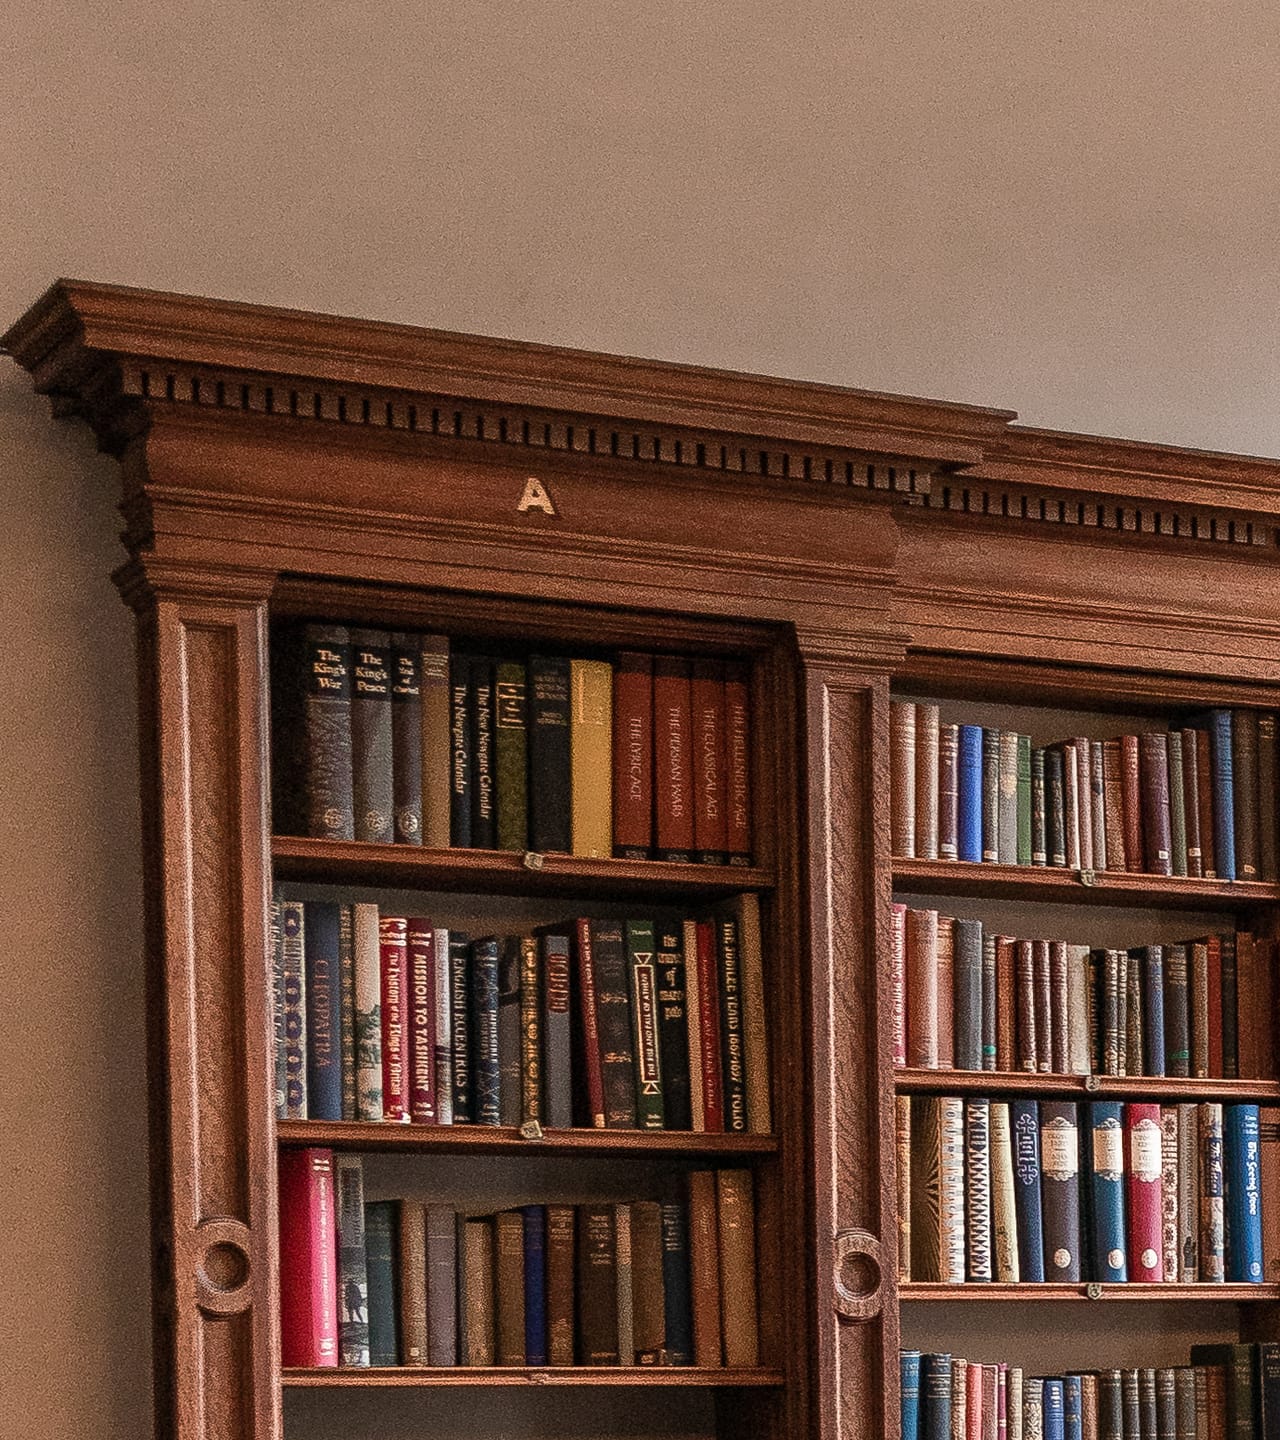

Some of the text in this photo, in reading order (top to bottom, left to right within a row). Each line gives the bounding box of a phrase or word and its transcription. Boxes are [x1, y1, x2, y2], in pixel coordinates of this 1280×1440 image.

[517, 477, 556, 515] A
[318, 650, 341, 662] The
[360, 652, 382, 665] The
[313, 663, 346, 677] King's
[355, 667, 387, 681] King's
[318, 678, 342, 690] War
[357, 681, 387, 694] Peace
[669, 707, 681, 730] THE
[704, 709, 716, 731] THE
[734, 705, 746, 727] THE
[453, 686, 468, 795] The Newgate Calendar
[476, 687, 493, 820] The New Newgate Calendar
[630, 717, 643, 801] THE LYRIC AGE
[706, 795, 718, 820] AGE
[723, 922, 736, 944] THE
[725, 946, 738, 992] JUBILEE
[413, 954, 430, 1092] MISSION TO TASHKENT
[453, 958, 469, 1088] ENGLISH ECCENTRICS
[643, 1013, 653, 1029] FALL
[644, 1030, 655, 1047] AND
[646, 1063, 656, 1077] THE
[731, 1094, 744, 1131] FOLIO
